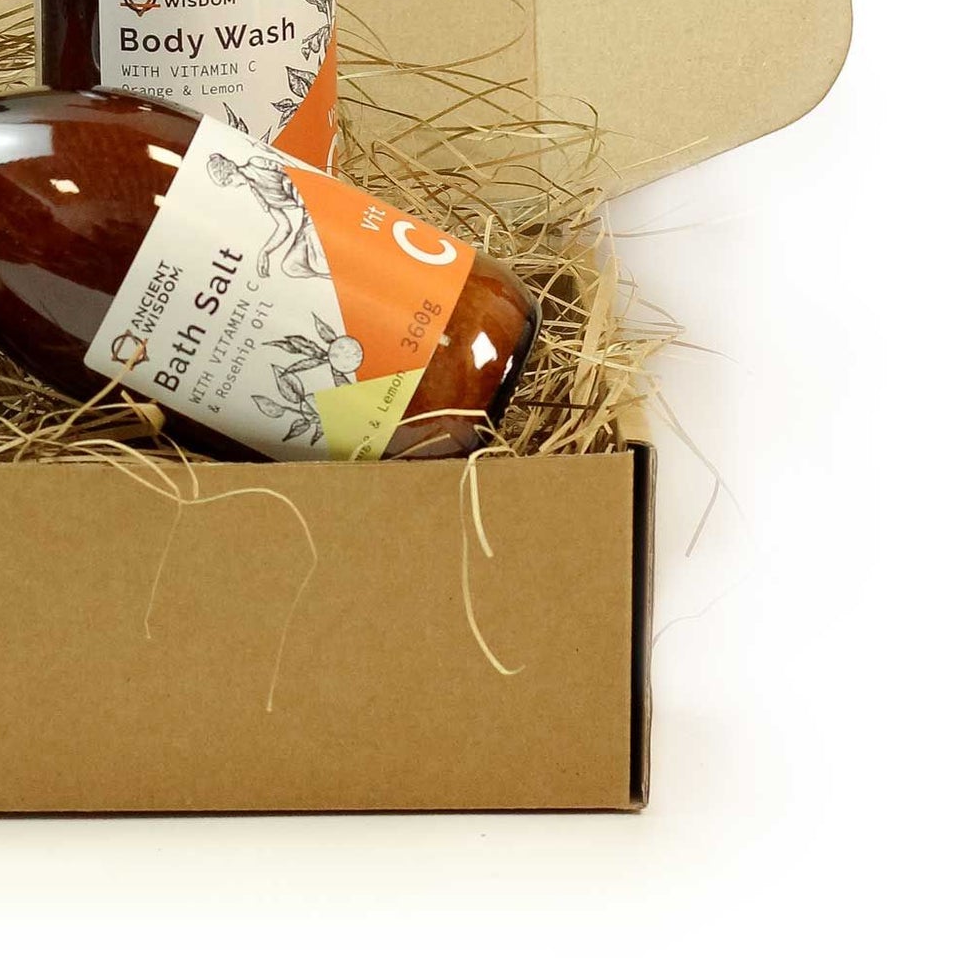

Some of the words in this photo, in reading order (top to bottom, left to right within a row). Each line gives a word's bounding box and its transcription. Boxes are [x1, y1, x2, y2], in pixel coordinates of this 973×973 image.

[120, 28, 204, 59] Body
[215, 17, 295, 50] Wash
[121, 64, 159, 78] WITH
[170, 63, 239, 77] VITAMIN
[248, 60, 257, 73] C
[182, 85, 192, 96] &
[201, 82, 244, 95] Lemon
[361, 205, 387, 233] Vit
[392, 219, 457, 266] C
[131, 259, 170, 329] ANCIENT
[141, 267, 184, 334] WISDOM
[153, 324, 206, 392] Bath
[194, 247, 243, 316] Salt
[189, 371, 214, 404] WITH
[209, 299, 250, 365] VITAMIN
[246, 281, 259, 292] C
[401, 299, 442, 354] 360g
[208, 404, 220, 414] &
[215, 338, 256, 399] Rosehip
[251, 301, 274, 330] Oil
[369, 419, 381, 429] &
